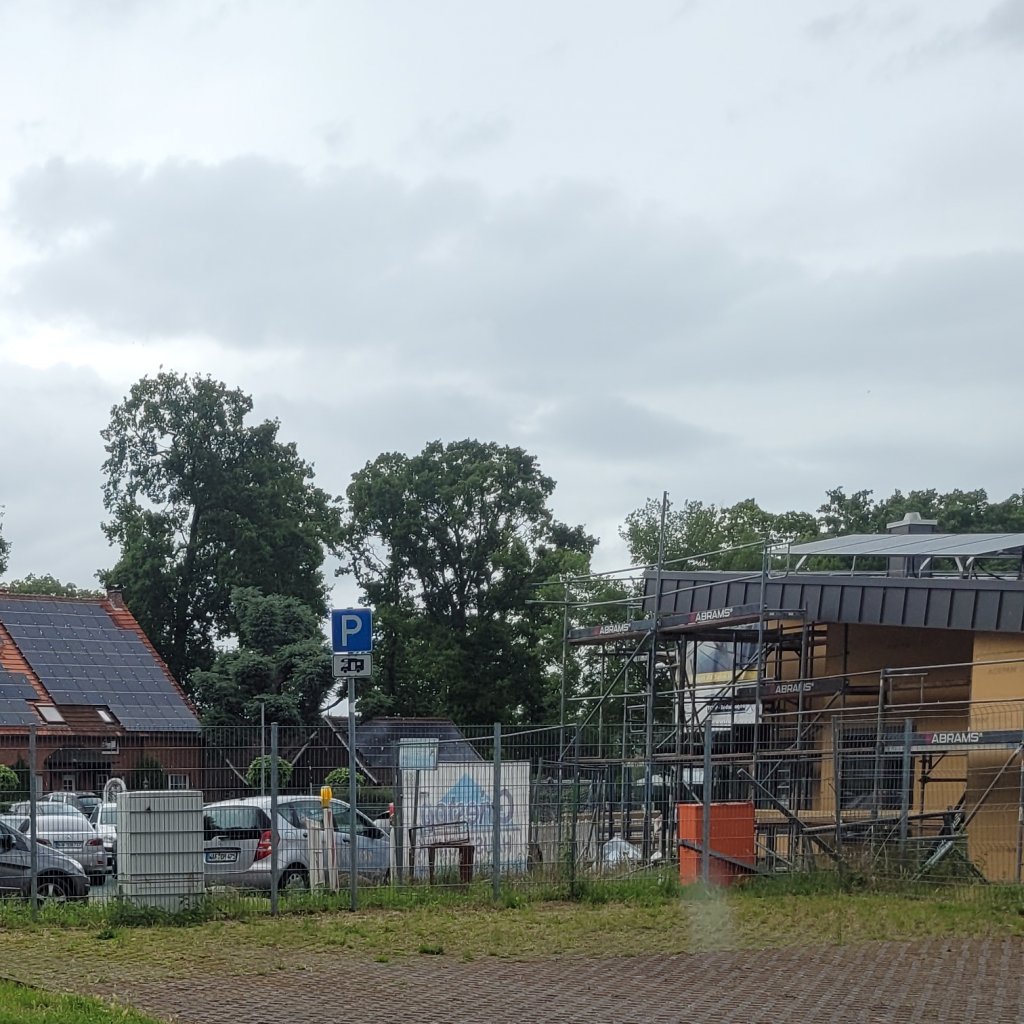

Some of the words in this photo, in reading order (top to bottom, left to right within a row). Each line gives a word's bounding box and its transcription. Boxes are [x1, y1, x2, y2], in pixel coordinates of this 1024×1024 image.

[695, 608, 731, 621] ABRAMS
[342, 615, 362, 646] P
[599, 623, 629, 634] ABRAMS
[931, 733, 979, 744] ABRAMS
